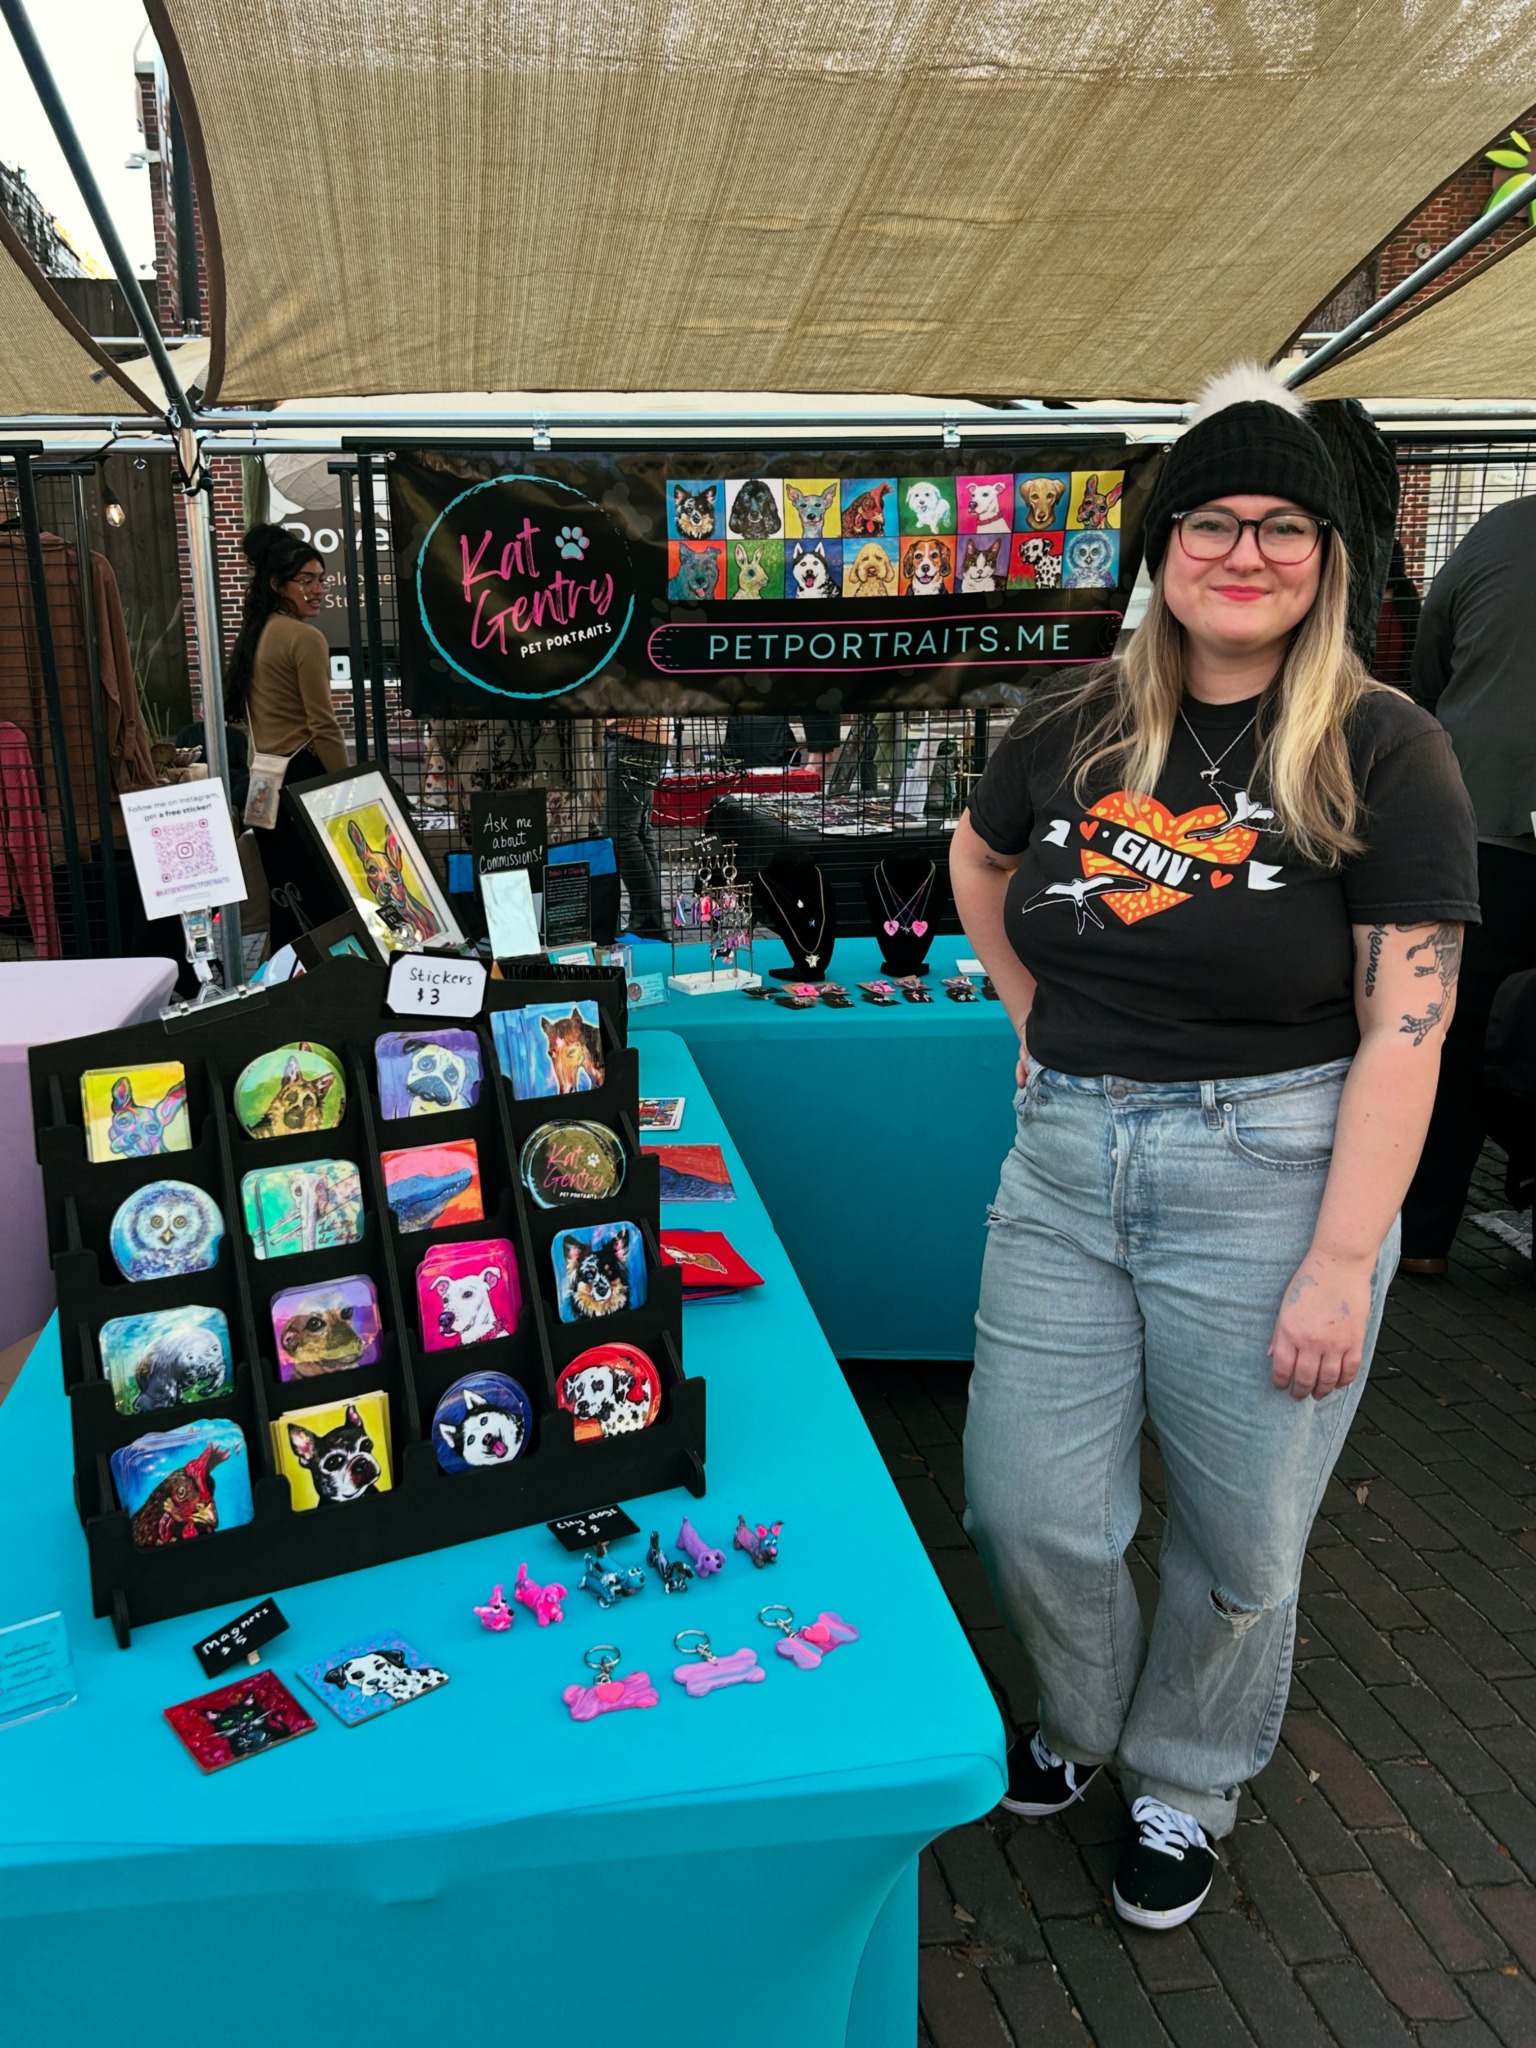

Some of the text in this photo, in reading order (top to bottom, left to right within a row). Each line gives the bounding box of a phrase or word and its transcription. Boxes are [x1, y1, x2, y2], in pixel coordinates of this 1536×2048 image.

[460, 517, 541, 603] Kat
[471, 570, 614, 655] Gentry
[520, 622, 612, 659] PET PORTRAITS
[708, 623, 1071, 661] PETPORTRAITS.ME
[127, 804, 152, 813] Follow
[168, 798, 178, 807] on
[144, 814, 157, 822] get
[165, 807, 182, 817] free
[182, 803, 212, 814] sticker!
[483, 812, 533, 834] Ask me
[492, 831, 527, 849] about
[479, 845, 543, 874] Commissions!
[1111, 830, 1194, 887] GNV
[409, 967, 473, 986] Stickers
[546, 1143, 583, 1169] Kat
[543, 1166, 603, 1194] Gentry
[556, 1508, 618, 1529] Clay dogs
